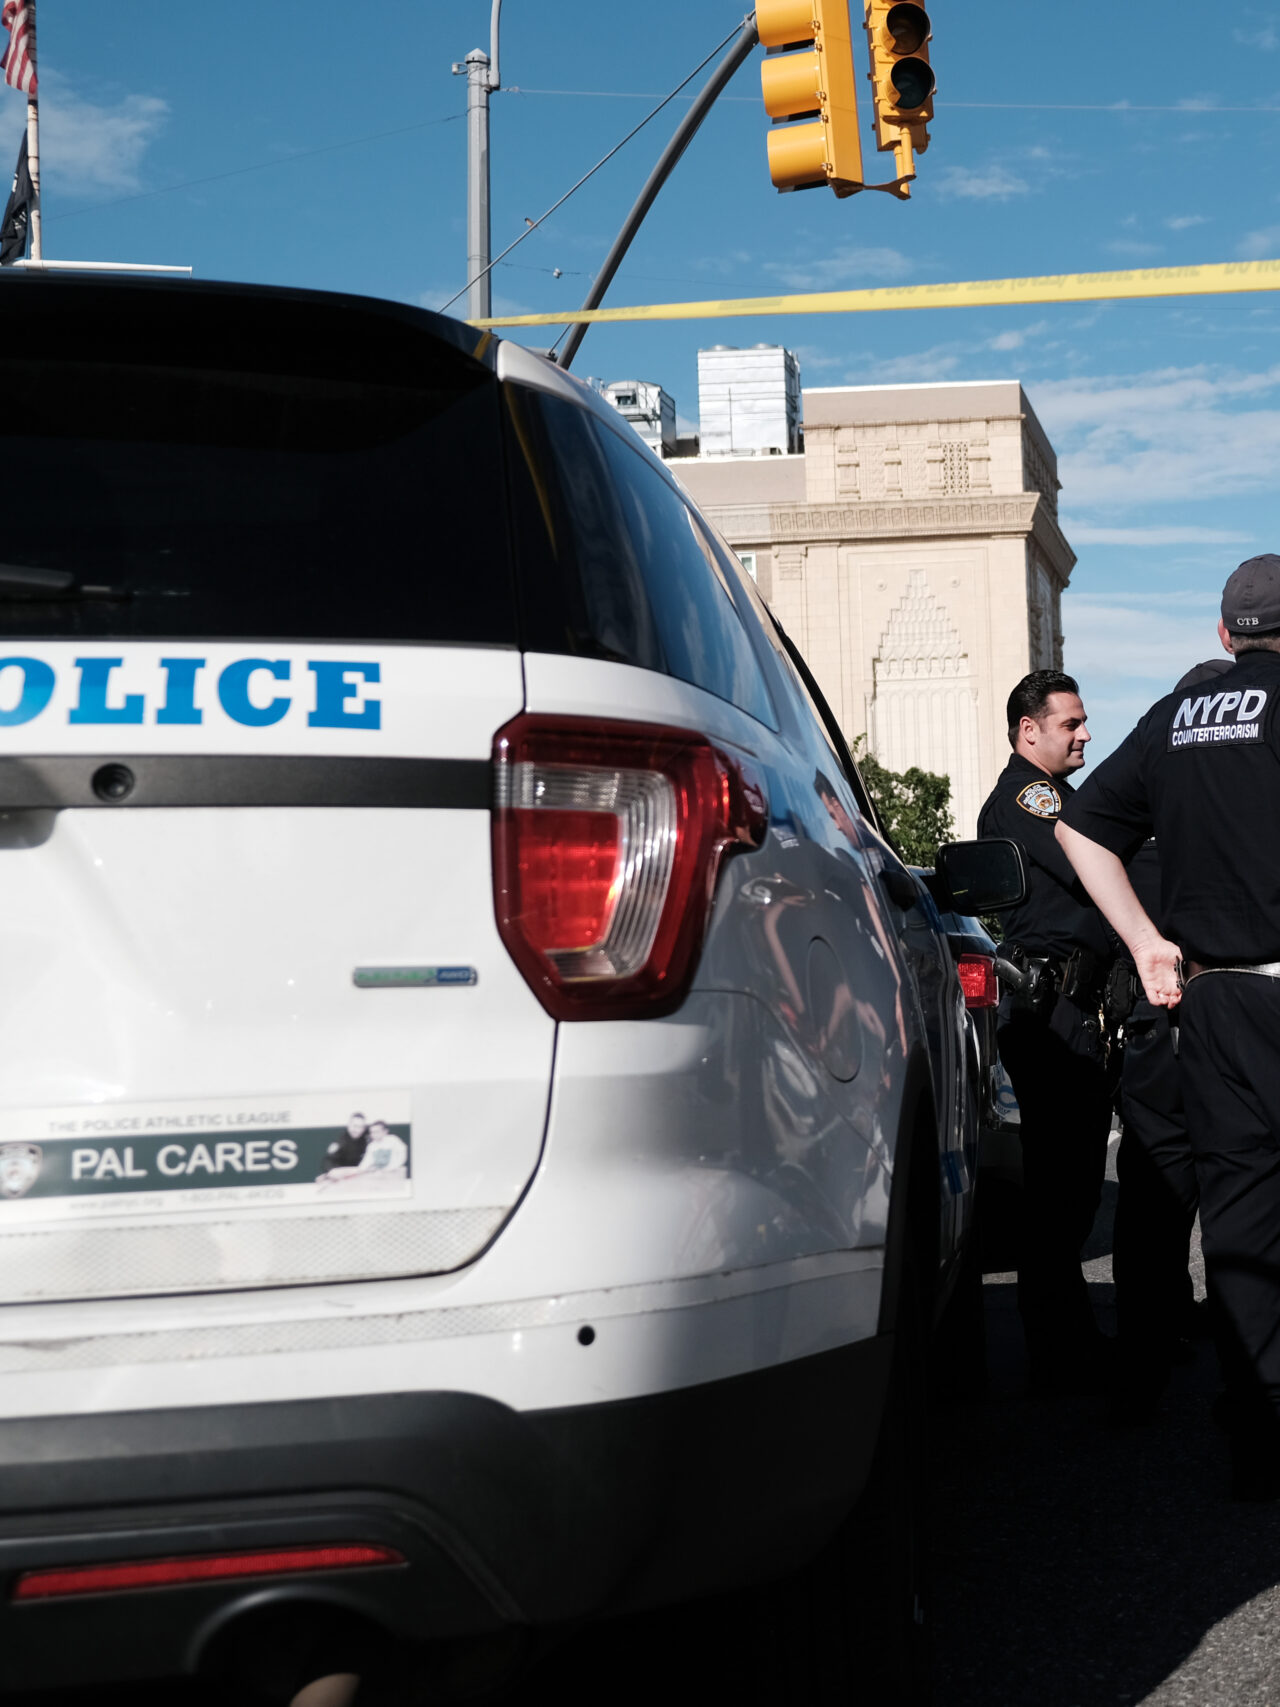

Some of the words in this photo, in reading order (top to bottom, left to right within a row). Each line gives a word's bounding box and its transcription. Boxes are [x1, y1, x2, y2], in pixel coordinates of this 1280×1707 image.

[1237, 617, 1259, 626] CTB
[0, 656, 381, 730] OLICE
[1172, 689, 1267, 729] NYPD
[1172, 723, 1259, 746] COUNTERTERRORISM
[50, 1120, 78, 1132] THE
[83, 1117, 141, 1131] POLICE
[145, 1113, 222, 1128] ATHLETIC
[226, 1110, 291, 1125] LEAGUE
[72, 1147, 147, 1180] PAL
[156, 1140, 299, 1176] CARES
